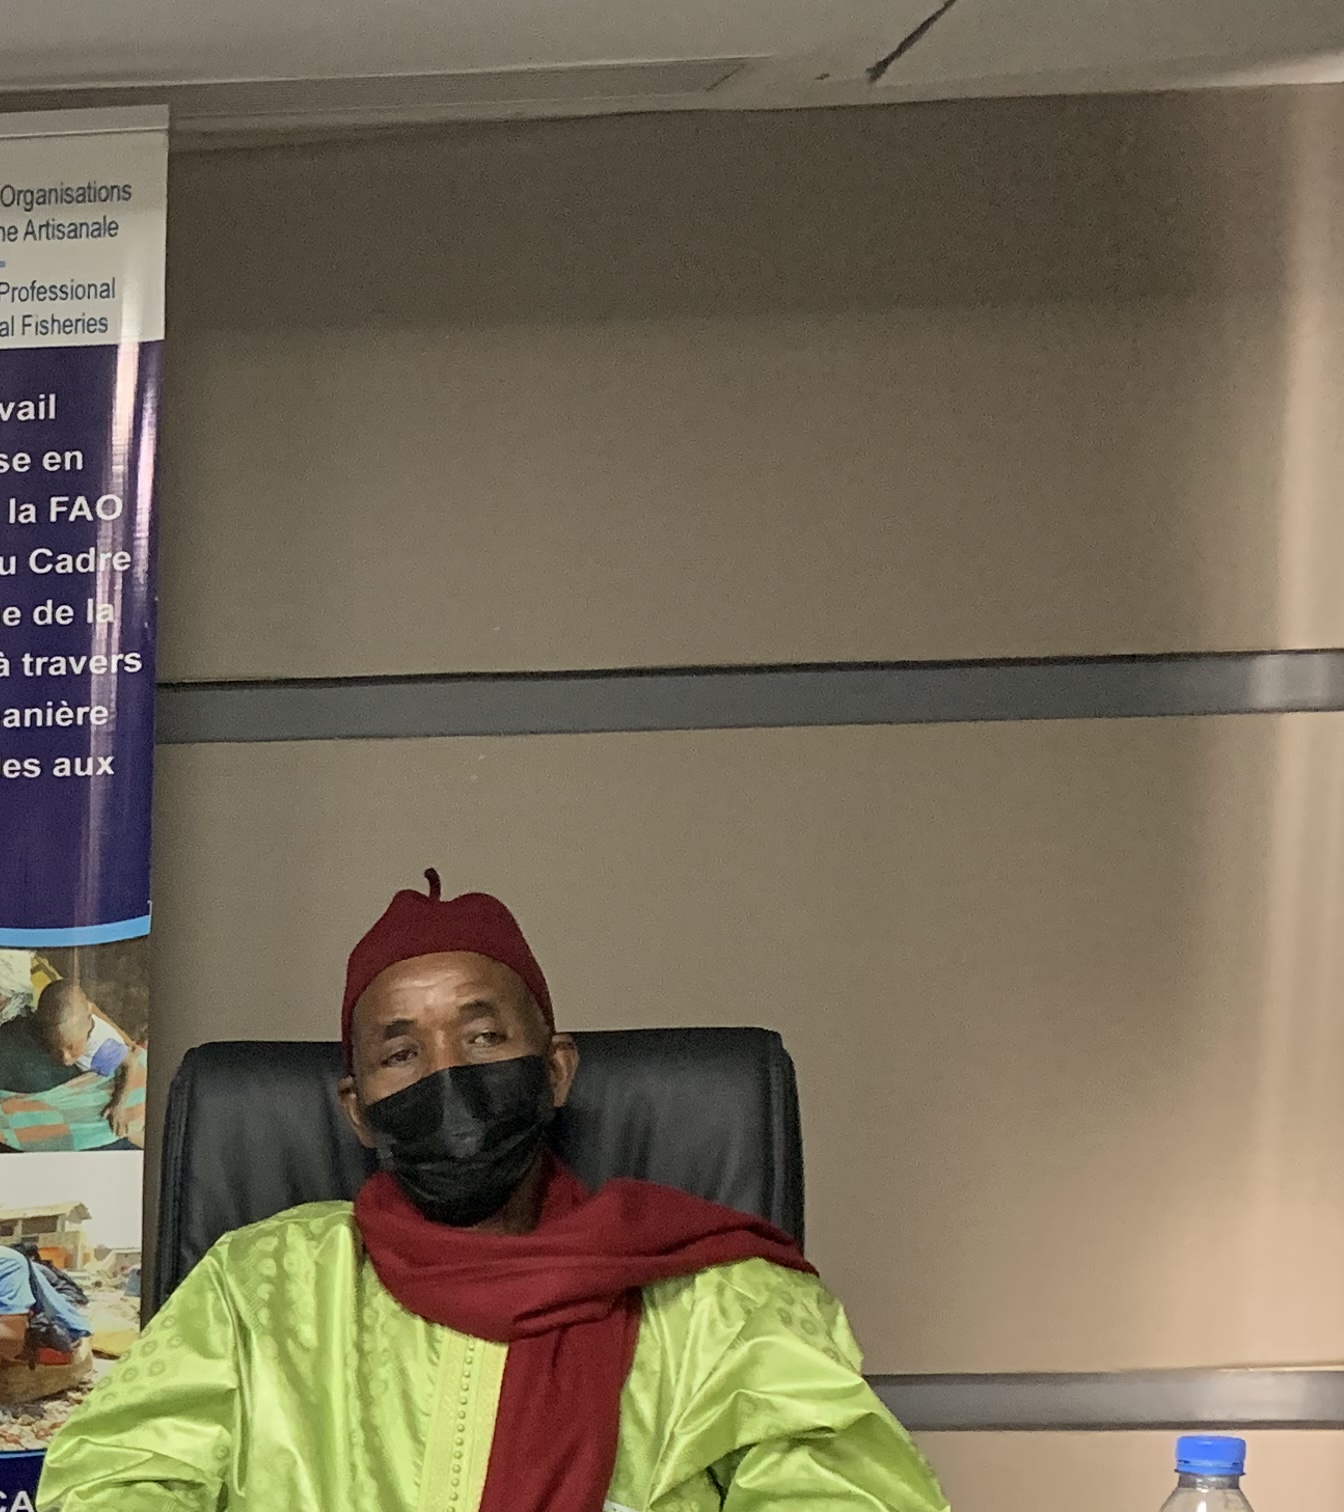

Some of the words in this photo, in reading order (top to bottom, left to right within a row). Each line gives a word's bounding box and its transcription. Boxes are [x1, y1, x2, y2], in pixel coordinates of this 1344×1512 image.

[0, 182, 131, 212] Organisations
[24, 214, 118, 241] Artisanale
[22, 313, 108, 336] Fisheries
[43, 450, 83, 472] en
[10, 499, 37, 523] la
[50, 494, 123, 522] FAO
[29, 548, 130, 576] Cadre
[33, 600, 73, 627] de
[88, 598, 115, 625] la
[22, 652, 141, 679] travers
[53, 756, 114, 778] aux
